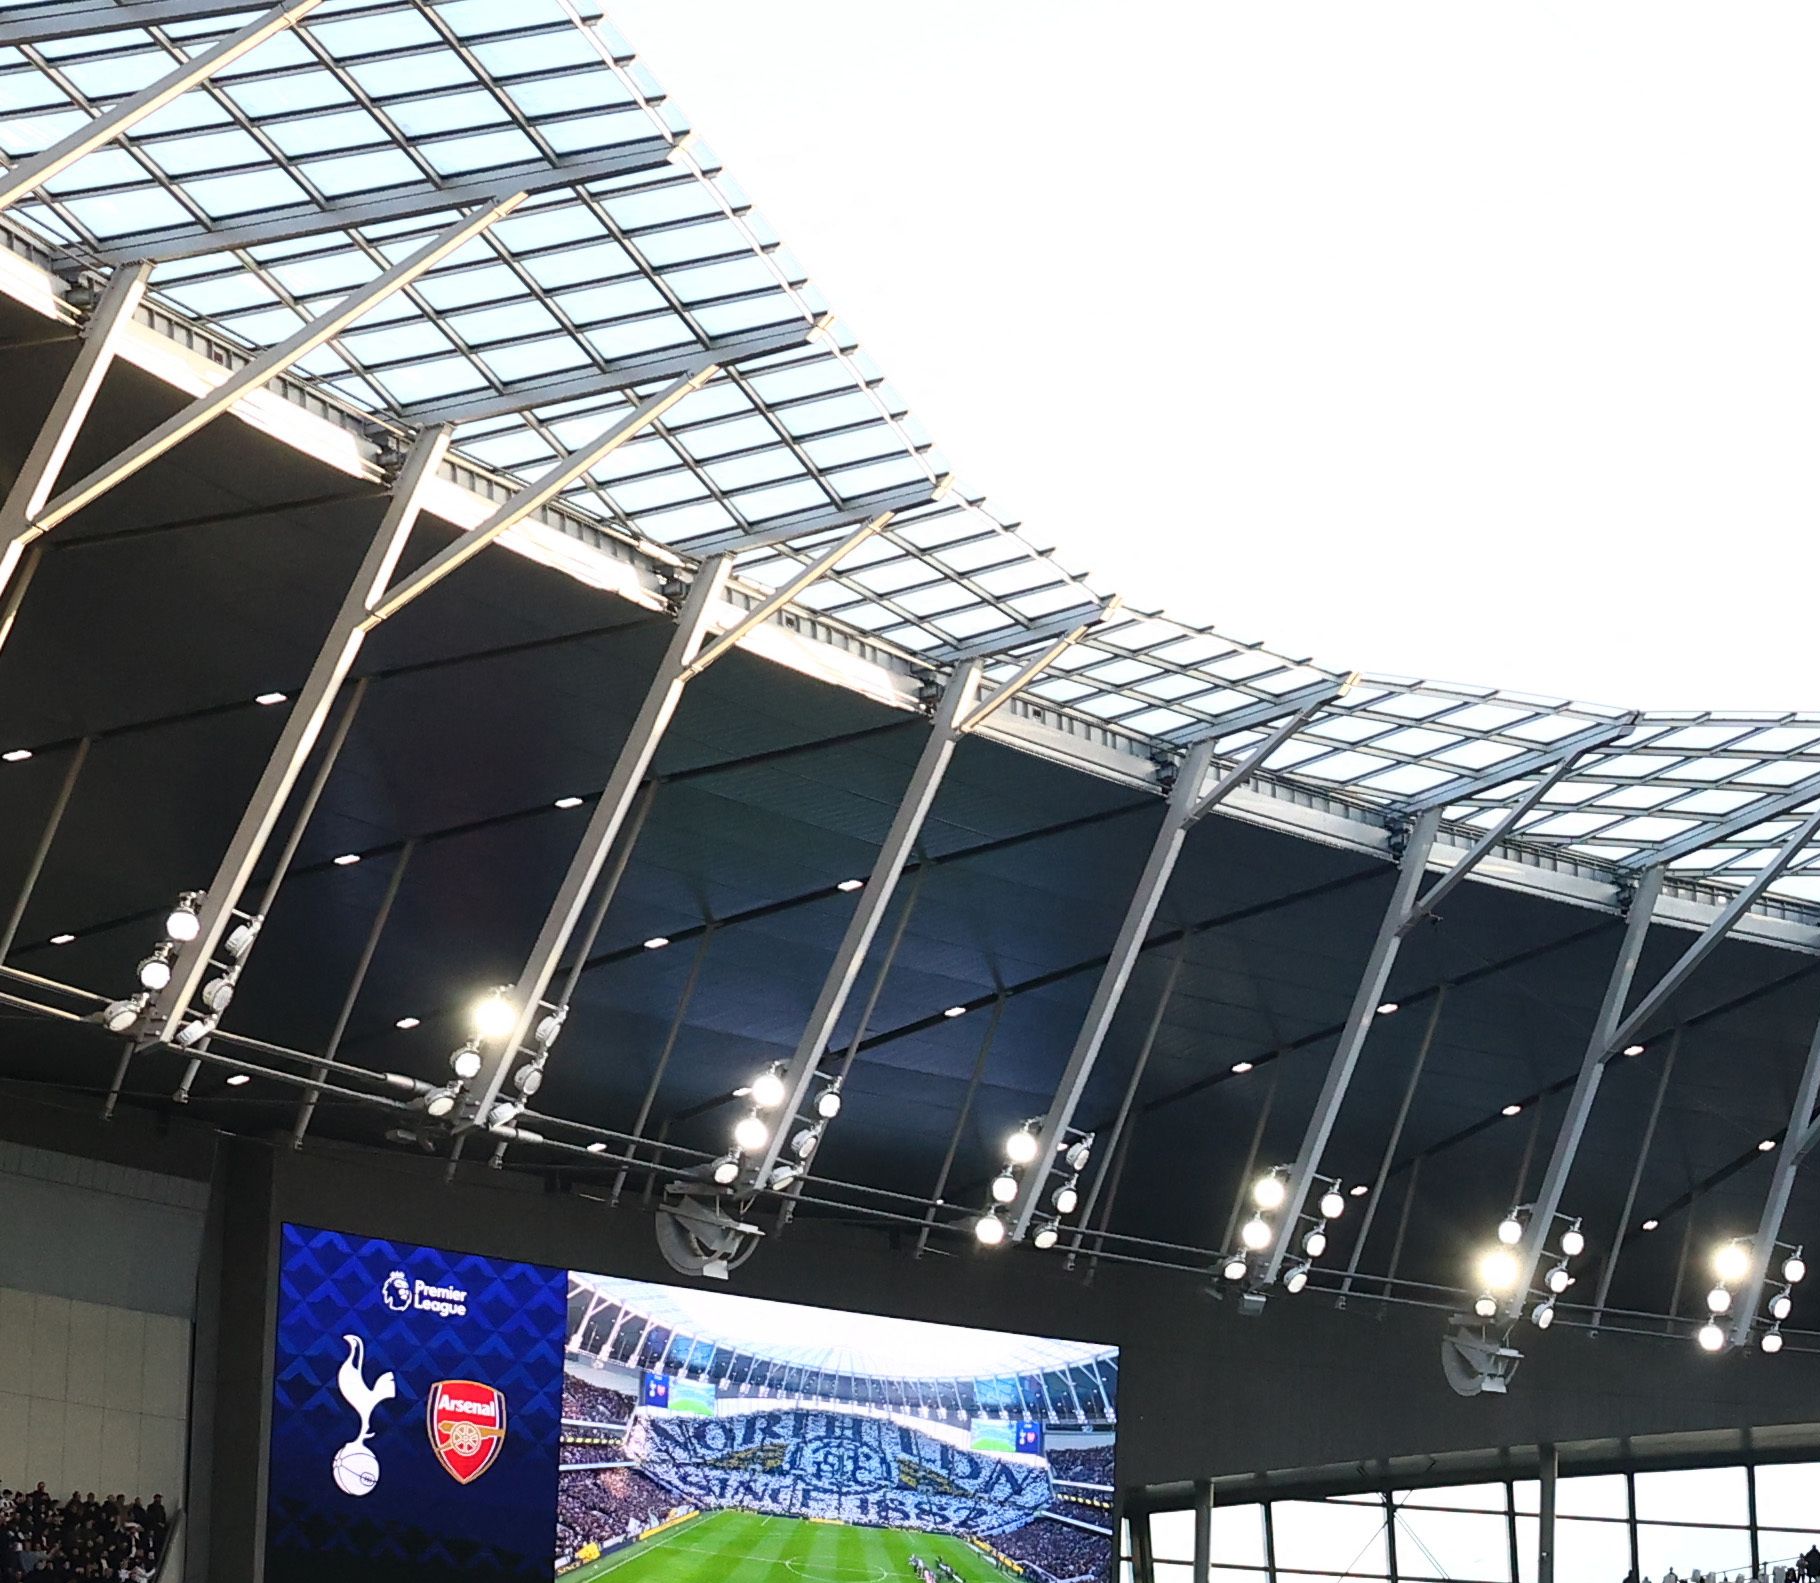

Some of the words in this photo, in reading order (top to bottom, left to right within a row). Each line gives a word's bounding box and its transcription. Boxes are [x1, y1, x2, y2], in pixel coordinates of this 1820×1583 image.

[415, 1280, 467, 1302] Premier
[414, 1293, 466, 1317] League
[439, 1395, 496, 1416] Arsenal
